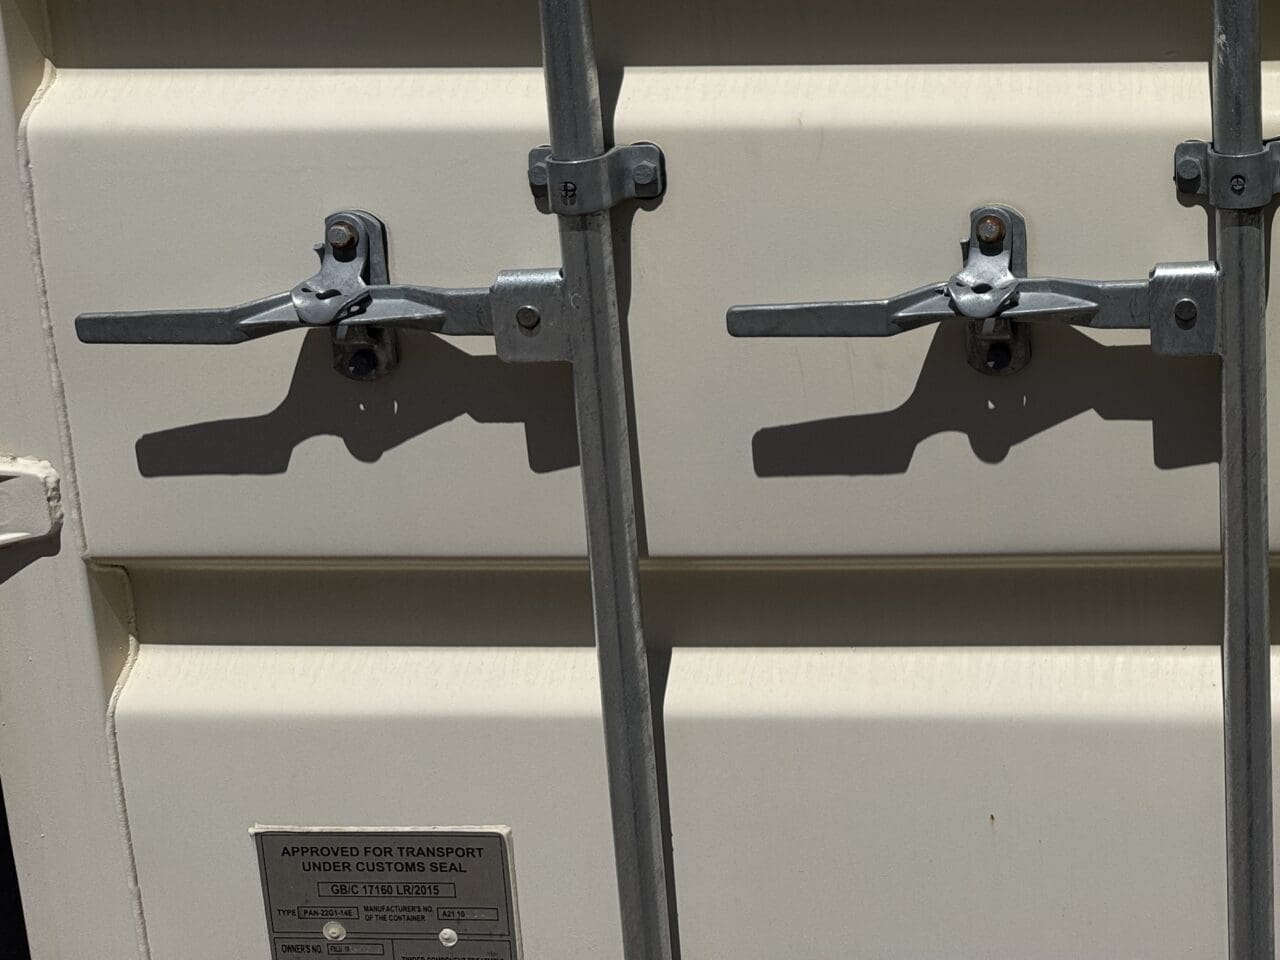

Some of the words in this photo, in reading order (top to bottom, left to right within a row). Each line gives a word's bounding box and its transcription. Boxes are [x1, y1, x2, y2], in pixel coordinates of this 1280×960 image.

[281, 846, 360, 858] APPROVED
[363, 846, 393, 858] FOR
[397, 846, 484, 858] TRANSPORT
[302, 861, 351, 872] UNDER
[355, 861, 426, 873] CUSTOMS
[429, 862, 467, 873] SEAL
[330, 884, 359, 895] GB/C
[362, 884, 393, 895] 17160
[396, 884, 440, 896] LR/2015
[277, 908, 297, 917] TYPE
[364, 914, 373, 922] OF
[375, 914, 387, 922] THE
[389, 914, 426, 922] CONTAINER
